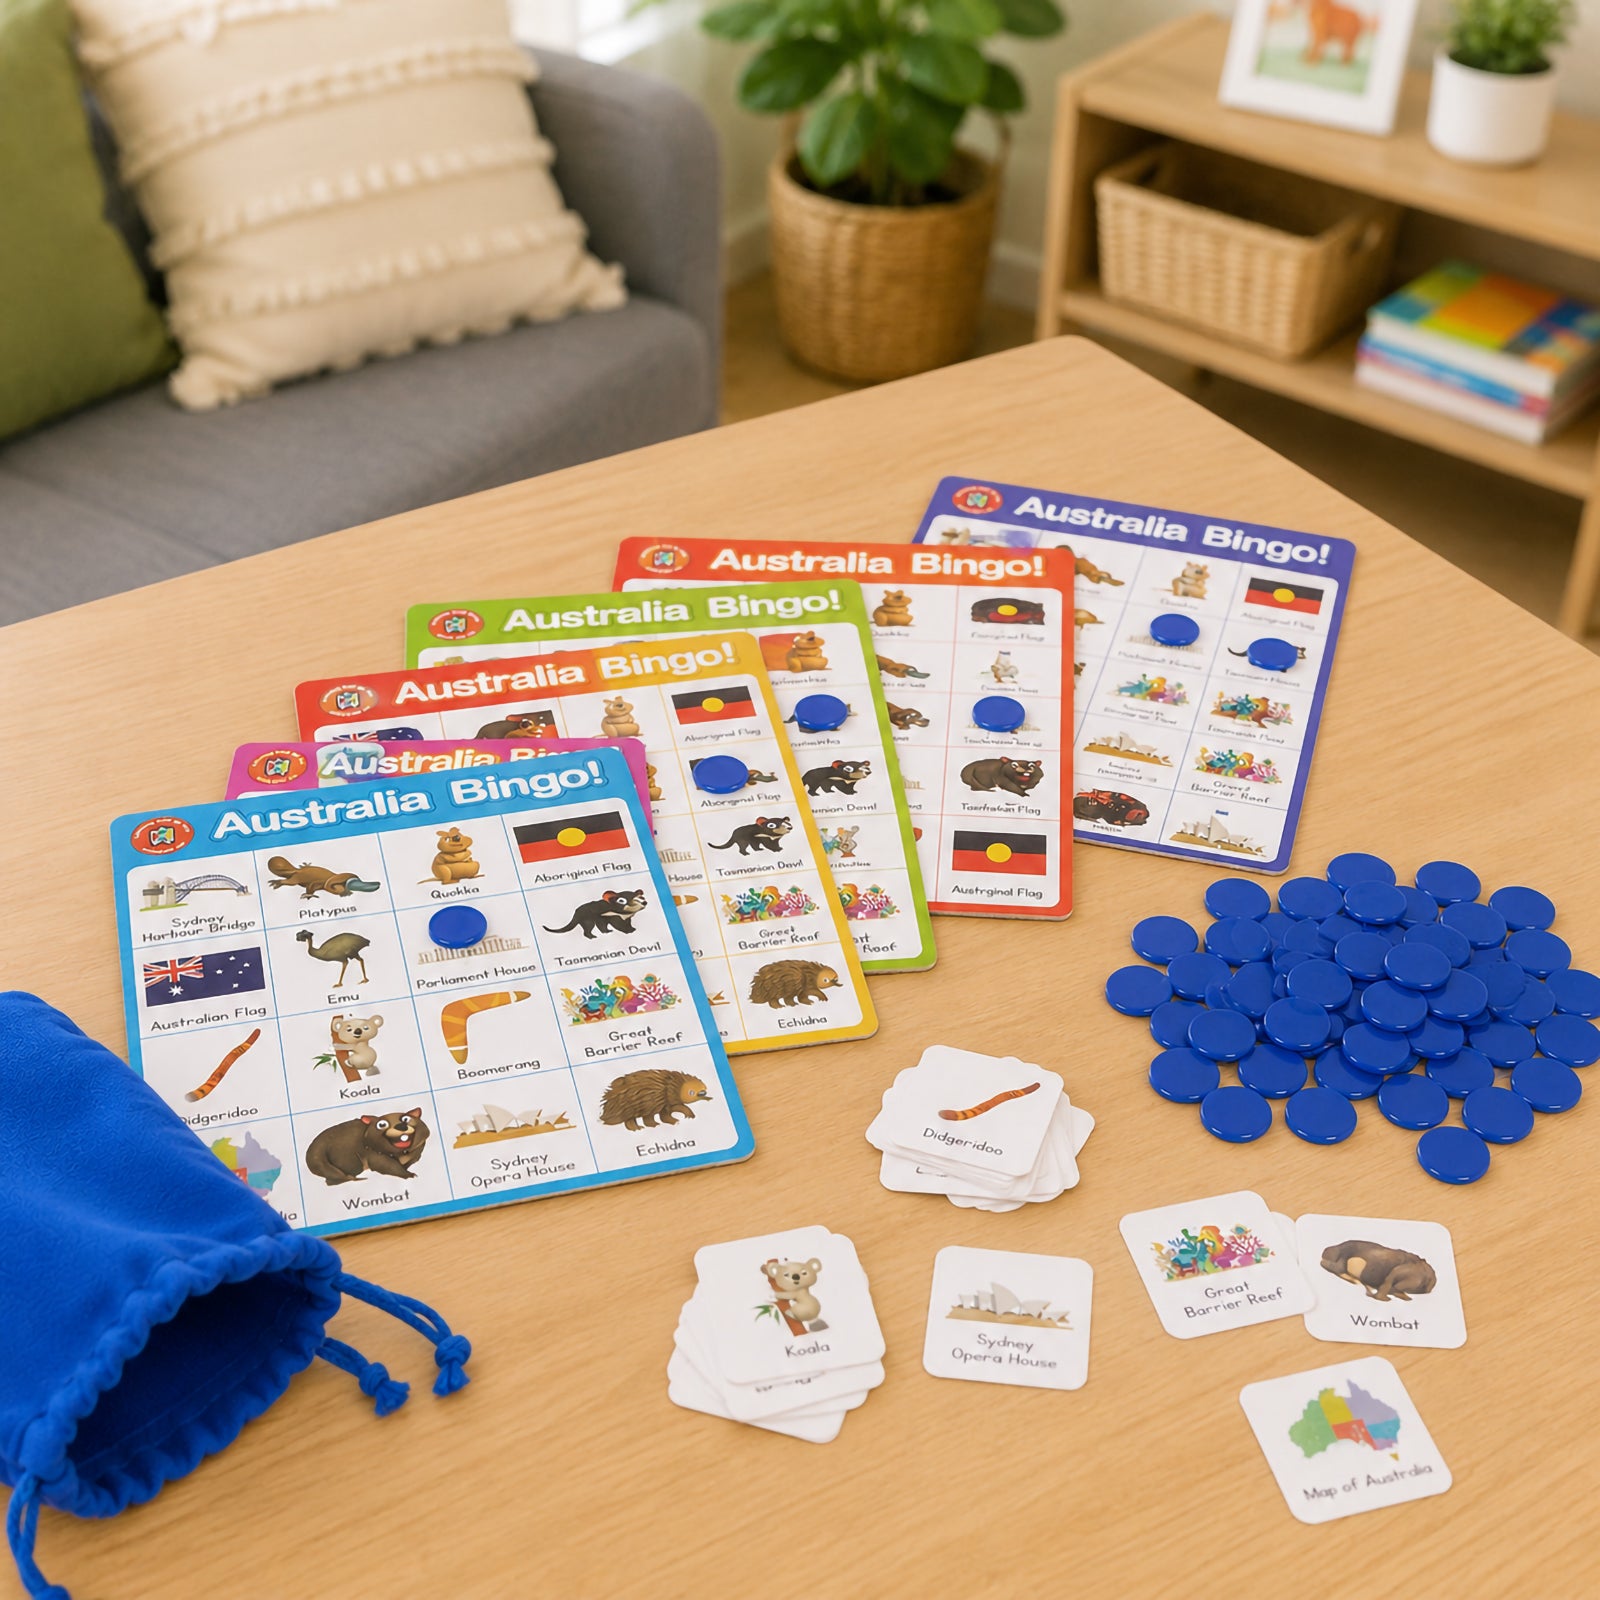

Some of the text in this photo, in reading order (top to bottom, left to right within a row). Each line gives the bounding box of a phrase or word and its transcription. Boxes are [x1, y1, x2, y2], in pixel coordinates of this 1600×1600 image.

[1013, 495, 1189, 542] Australia
[1202, 524, 1331, 565] Bingo!
[710, 548, 893, 575] Australia
[911, 552, 1044, 581] Bingo!
[503, 600, 689, 632] Australia
[708, 589, 842, 620] Bingo!
[395, 664, 586, 704] Australia
[600, 641, 736, 679] Bingo!
[322, 749, 495, 776] Australia
[213, 791, 430, 839] Australia
[450, 760, 604, 805] Bingo!
[534, 861, 632, 884] Aboriginal Flag
[430, 885, 480, 900] Quokka
[1017, 887, 1043, 900] Flag
[299, 905, 357, 919] Platypus
[171, 914, 225, 930] Sydney
[554, 950, 625, 967] Tasmanian
[416, 962, 536, 990] Parliament House
[328, 992, 359, 1005] Emu
[150, 1006, 267, 1032] Australian Flag
[777, 1015, 828, 1030] Echidna
[608, 1026, 653, 1042] Great
[584, 1041, 642, 1058] Barrier
[457, 1059, 541, 1080] Boomerang
[339, 1085, 380, 1100] Koala
[636, 1139, 696, 1157] Echidna
[923, 1126, 1003, 1157] Didgeridoo
[490, 1154, 549, 1172] Sydney
[471, 1161, 576, 1190] Opera House
[342, 1190, 410, 1210] Wombat
[1204, 1282, 1250, 1299] Great
[1184, 1287, 1283, 1318] Barrier Reef
[1350, 1314, 1420, 1330] Wombat
[784, 1343, 831, 1358] Koala
[976, 1334, 1034, 1352] Sydney
[951, 1347, 1057, 1370] Opera House
[1303, 1464, 1433, 1501] Map of Australia
